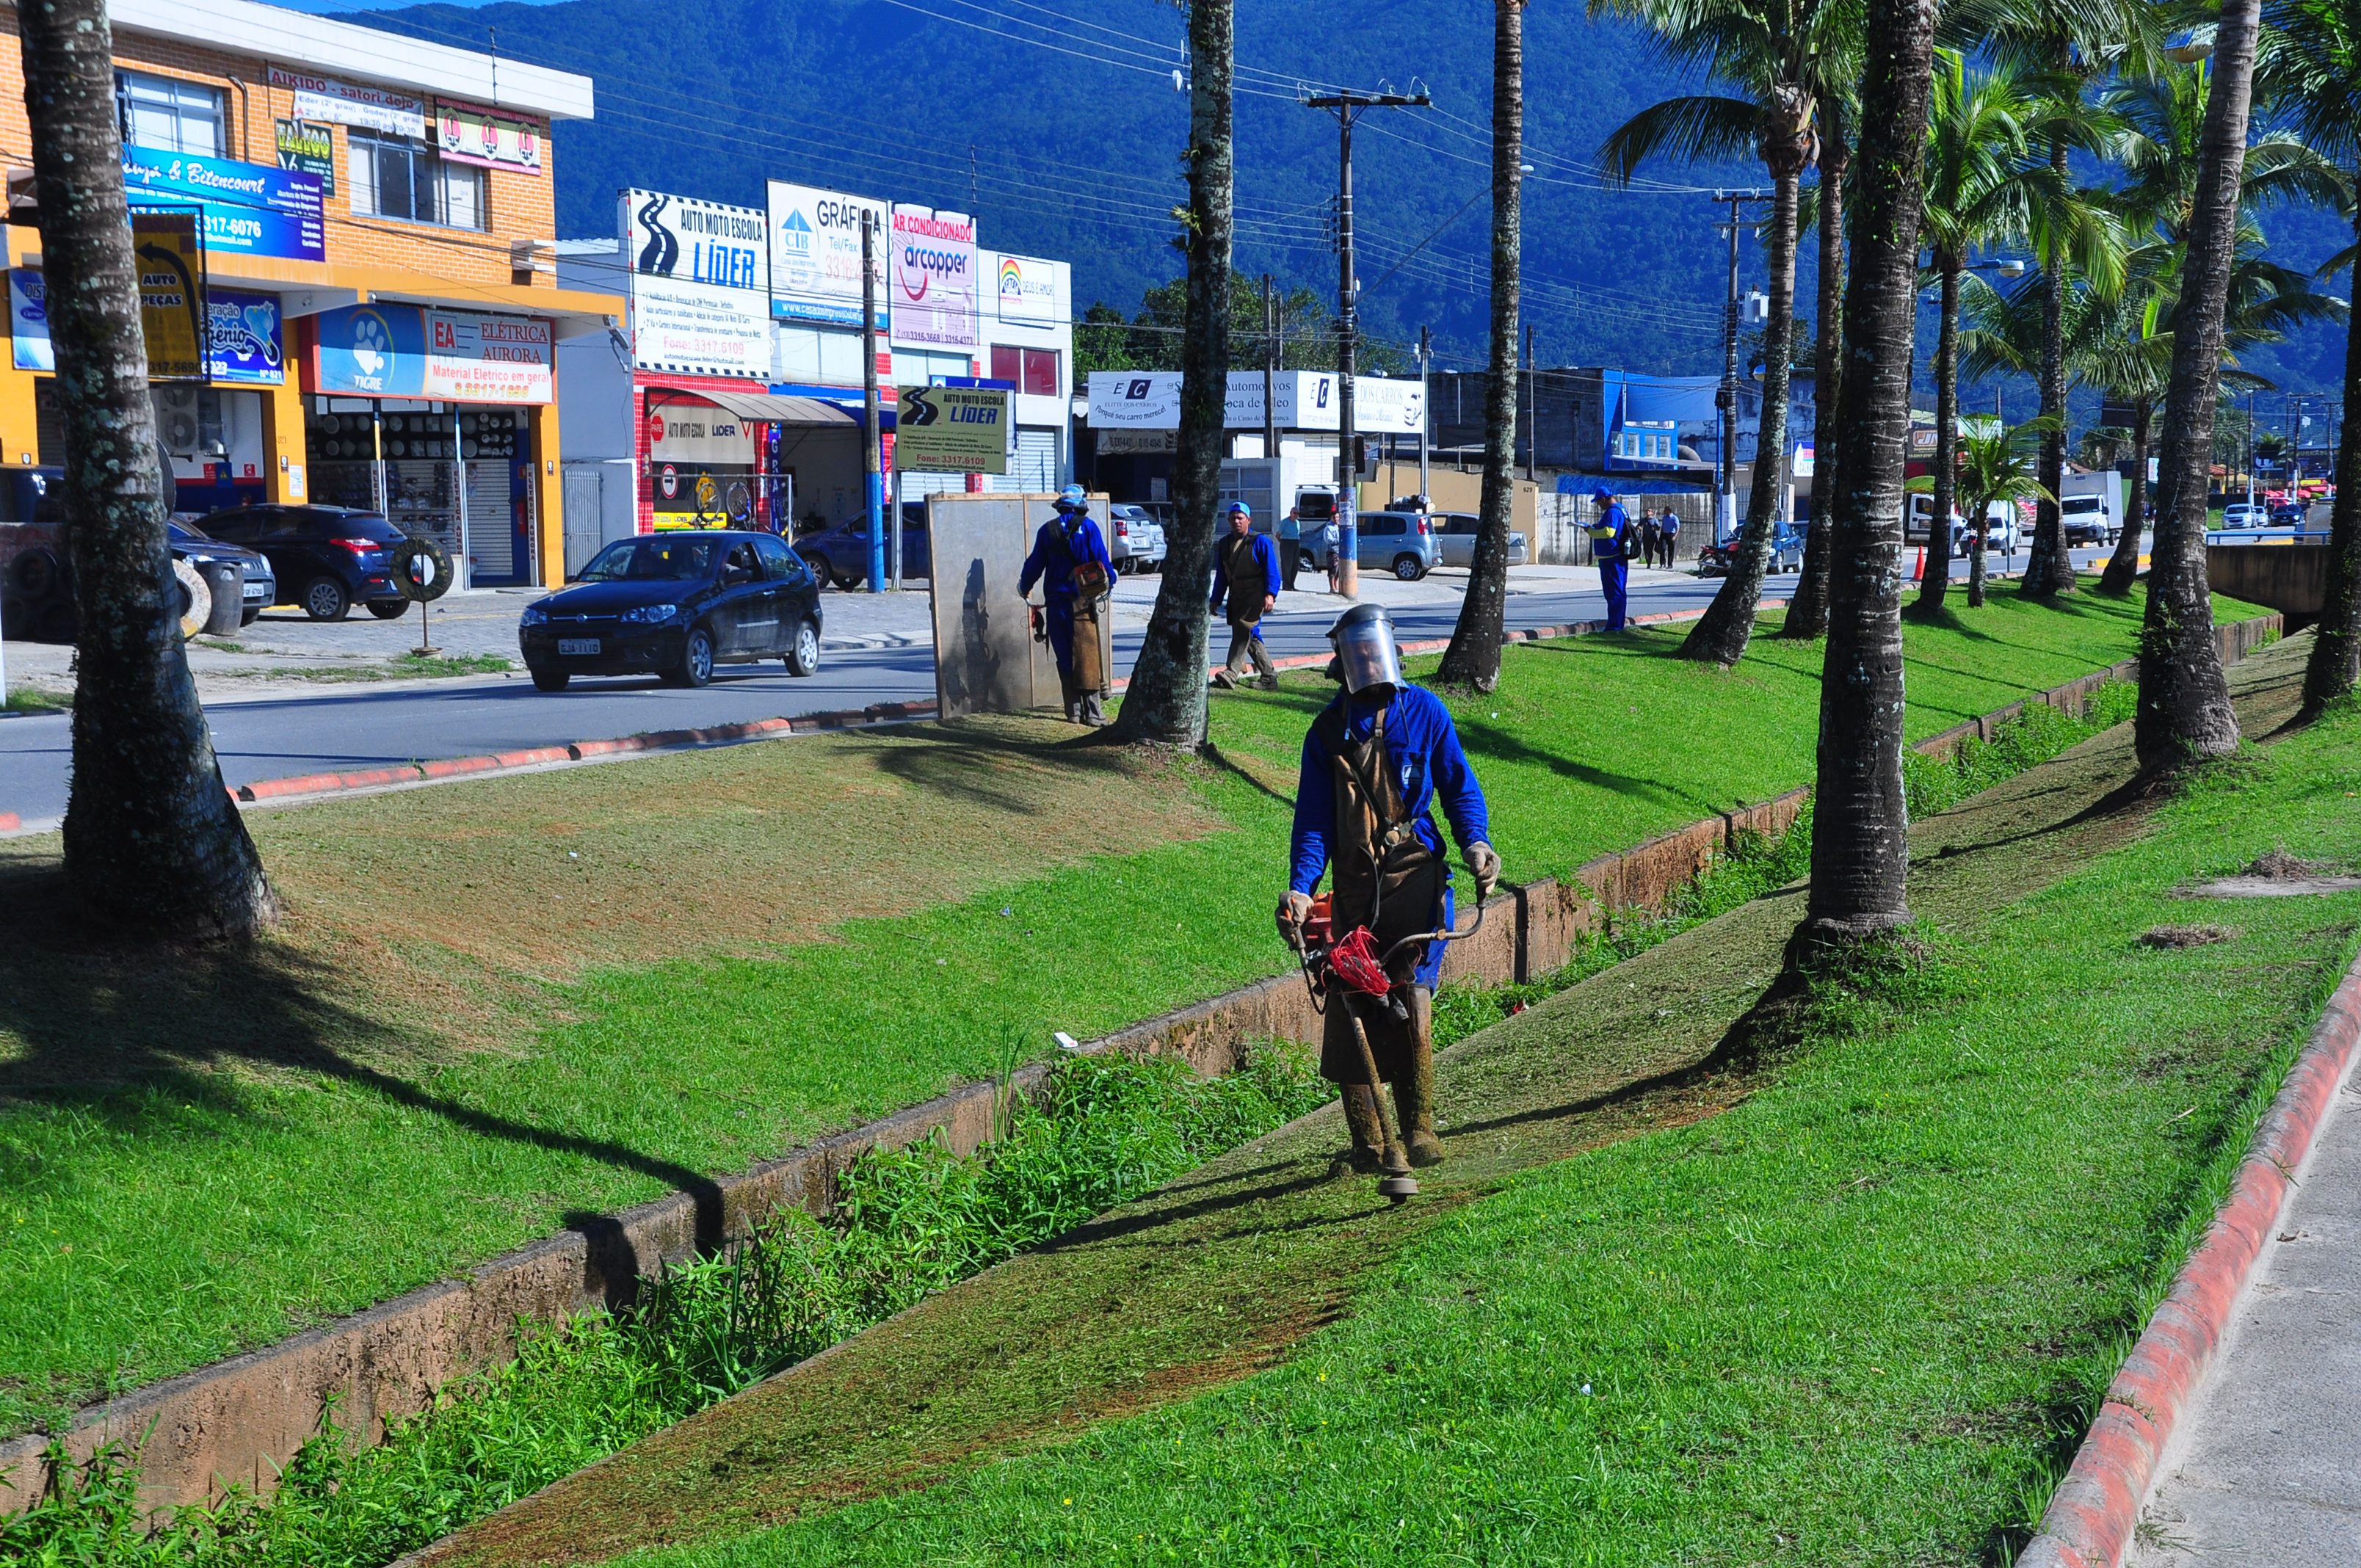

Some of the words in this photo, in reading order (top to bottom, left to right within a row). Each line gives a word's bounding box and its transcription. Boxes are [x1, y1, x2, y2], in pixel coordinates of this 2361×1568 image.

[272, 71, 326, 92] AIKIDO
[341, 87, 380, 102] satori
[385, 94, 414, 109] dojo
[299, 95, 319, 104] Eder
[169, 159, 181, 180] &
[186, 162, 265, 194] Bitencourt
[681, 208, 703, 233] AUTO
[706, 212, 730, 237] MOTO
[731, 217, 763, 242] ESCOLA
[817, 197, 882, 236] GRÁFIA
[893, 213, 905, 231] AR
[908, 216, 971, 242] CONDICIONADO
[786, 233, 809, 250] CIB
[829, 236, 857, 252] Tel/Fax
[693, 239, 755, 290] LÍDER
[904, 246, 968, 280] arcopper
[142, 275, 177, 286] AUTO
[141, 295, 182, 309] PEÇAS
[435, 322, 456, 349] EA
[481, 321, 548, 341] ELÉTRICA
[664, 336, 691, 349] Fone:
[694, 339, 744, 355] 3317.6109
[482, 346, 542, 363] AURORA
[149, 361, 202, 374] 317-5690
[432, 364, 471, 380] Material
[512, 372, 525, 382] em
[527, 371, 549, 385] geral
[354, 375, 382, 390] TIGRE
[1113, 382, 1125, 394] E
[1134, 382, 1146, 396] C
[1225, 382, 1291, 391] utomovos
[943, 393, 960, 403] AUTO
[961, 394, 979, 404] MOTO
[981, 396, 1004, 406] ESCOLA
[1226, 399, 1244, 408] oca
[1247, 397, 1260, 408] de
[1360, 385, 1374, 404] DOS
[1375, 386, 1403, 405] CARROS
[950, 404, 998, 424] LÍDER
[1144, 404, 1167, 419] merece!
[668, 422, 678, 438] AUTO
[679, 422, 691, 438] MOTO
[692, 422, 706, 438] ESCOLA
[712, 424, 736, 438] LIDER
[916, 454, 939, 462] Fone:
[941, 455, 985, 465] 3317.6109
